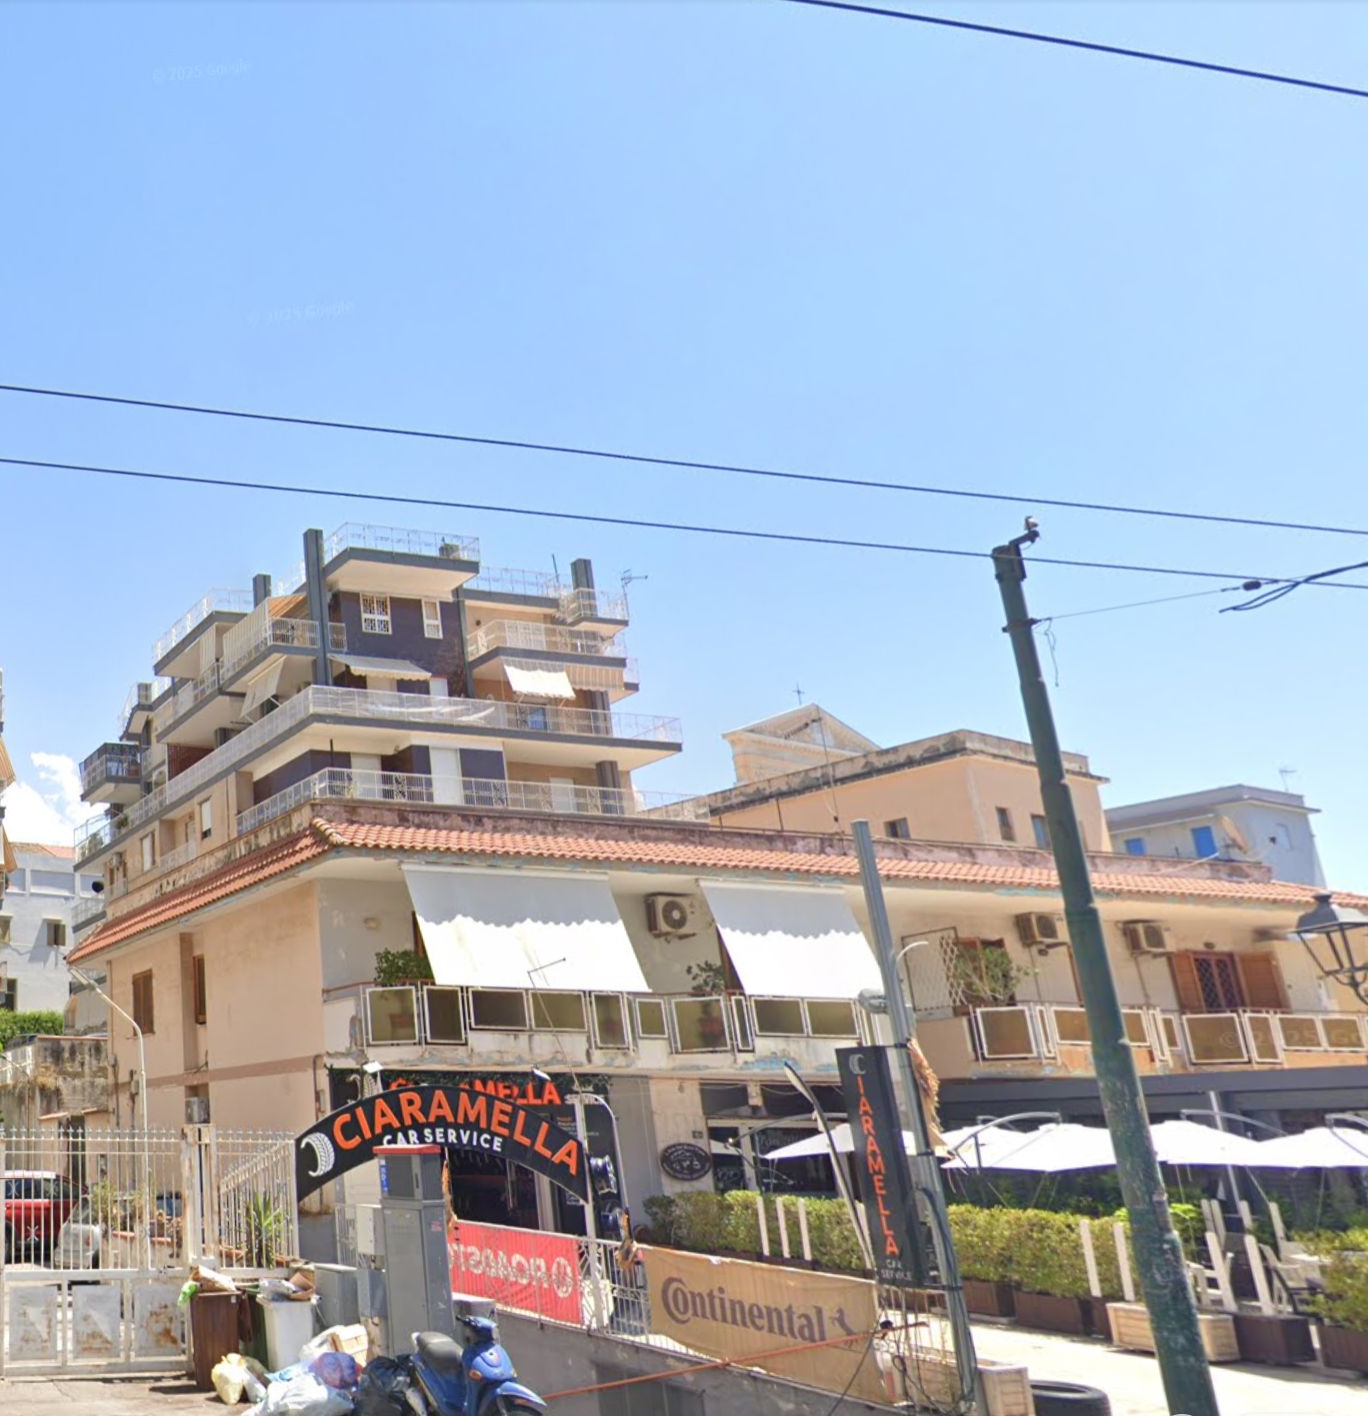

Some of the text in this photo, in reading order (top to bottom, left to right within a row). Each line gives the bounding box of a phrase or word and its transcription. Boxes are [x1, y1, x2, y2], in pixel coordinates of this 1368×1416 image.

[332, 1089, 579, 1177] CIARAMELLA
[383, 1127, 503, 1152] CAR SERVICE
[849, 1053, 901, 1256] CIARAMELLA
[661, 1276, 828, 1343] Continental
